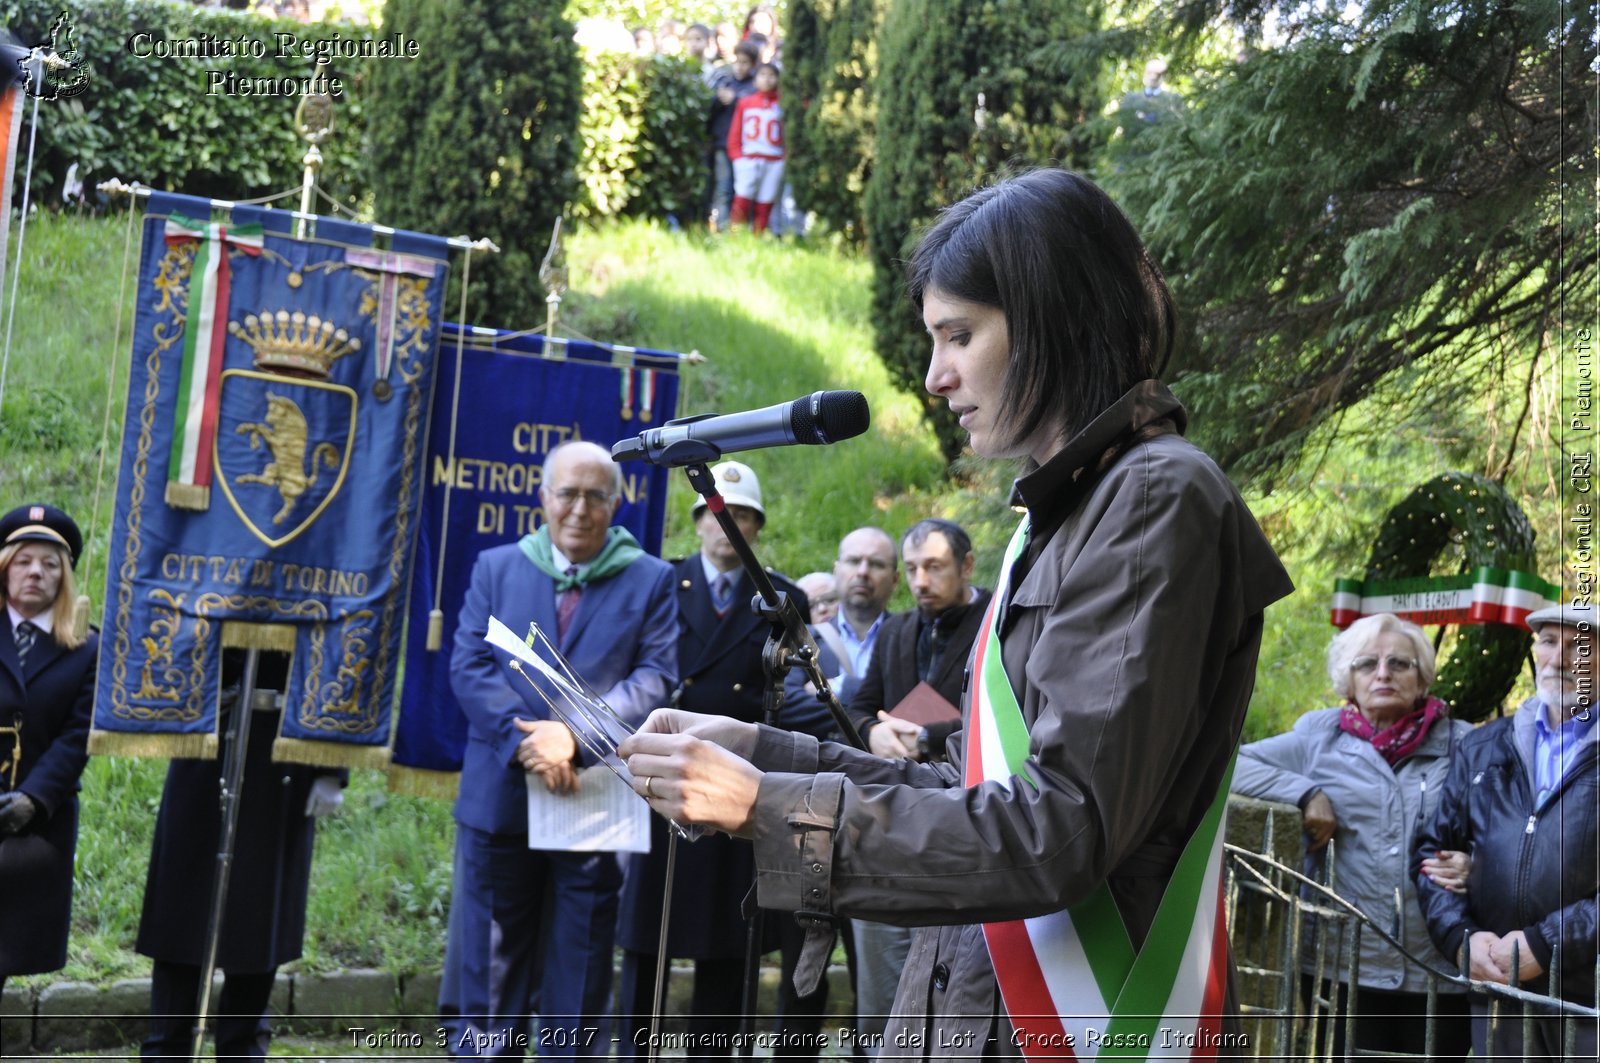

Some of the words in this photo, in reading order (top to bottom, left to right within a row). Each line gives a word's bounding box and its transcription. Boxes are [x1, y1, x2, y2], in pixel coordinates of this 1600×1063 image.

[743, 115, 784, 145] 30
[432, 455, 648, 504] METROPNA
[477, 503, 505, 535] DI
[252, 559, 274, 587] DI
[282, 564, 369, 597] TORINO
